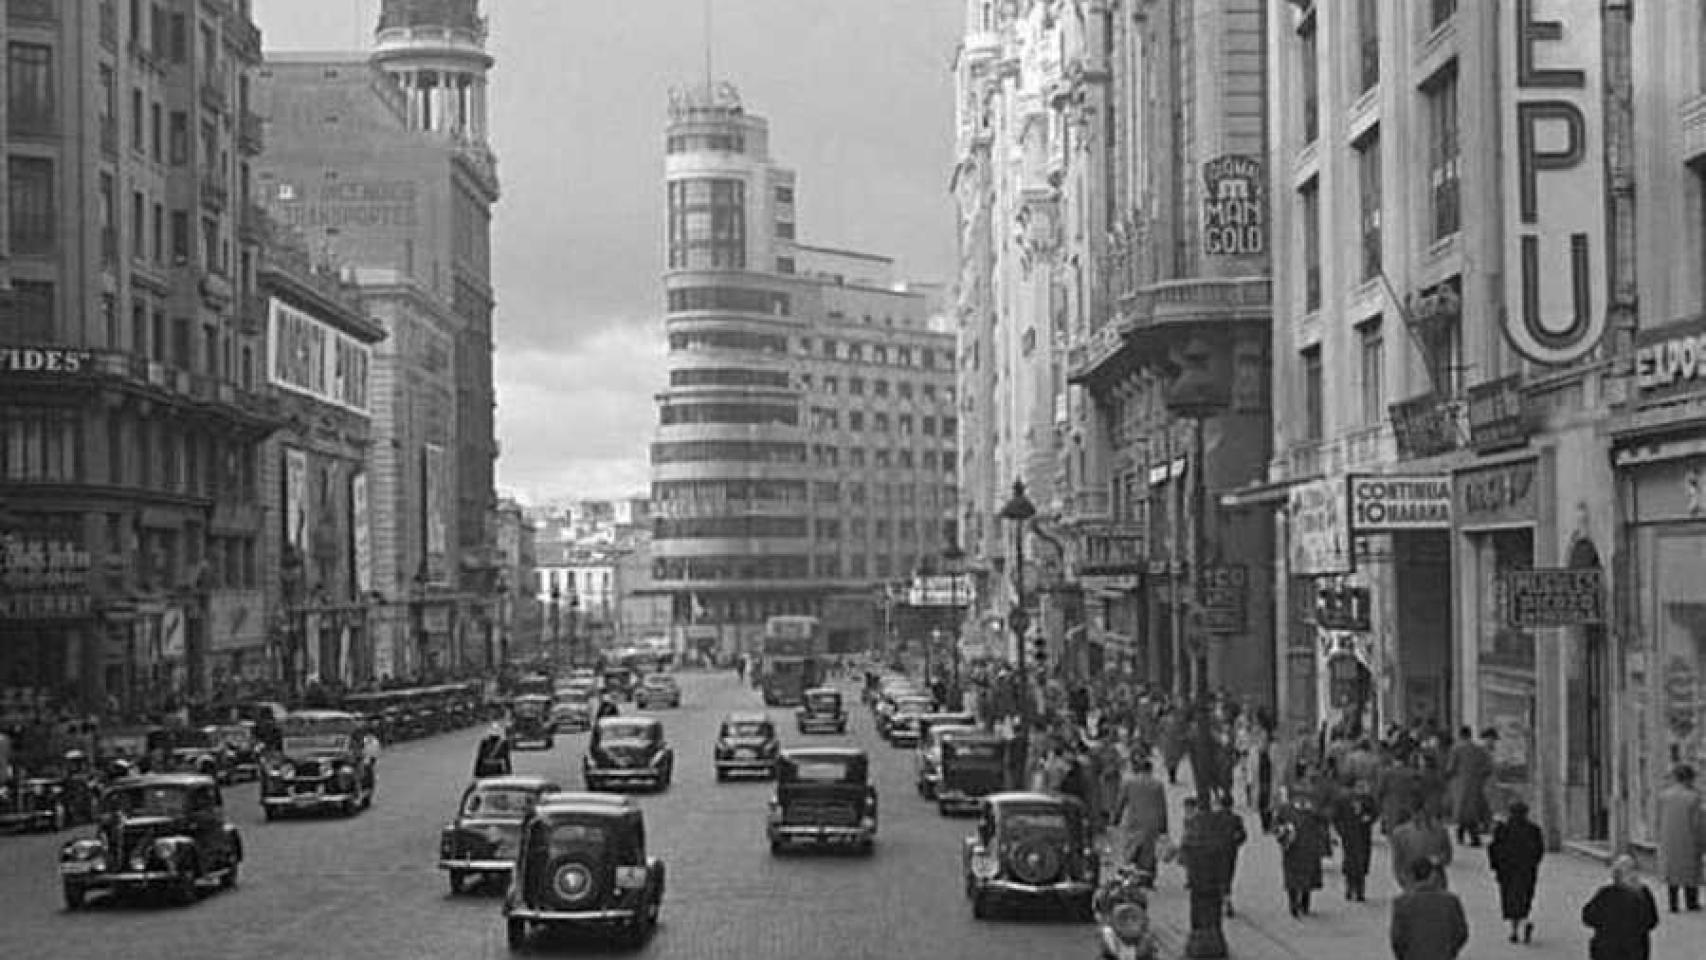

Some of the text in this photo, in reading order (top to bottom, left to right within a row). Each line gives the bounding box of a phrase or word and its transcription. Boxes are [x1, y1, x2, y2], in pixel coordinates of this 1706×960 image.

[1205, 200, 1262, 224] MAN
[1206, 227, 1262, 253] GOLD
[1358, 502, 1385, 523] 10
